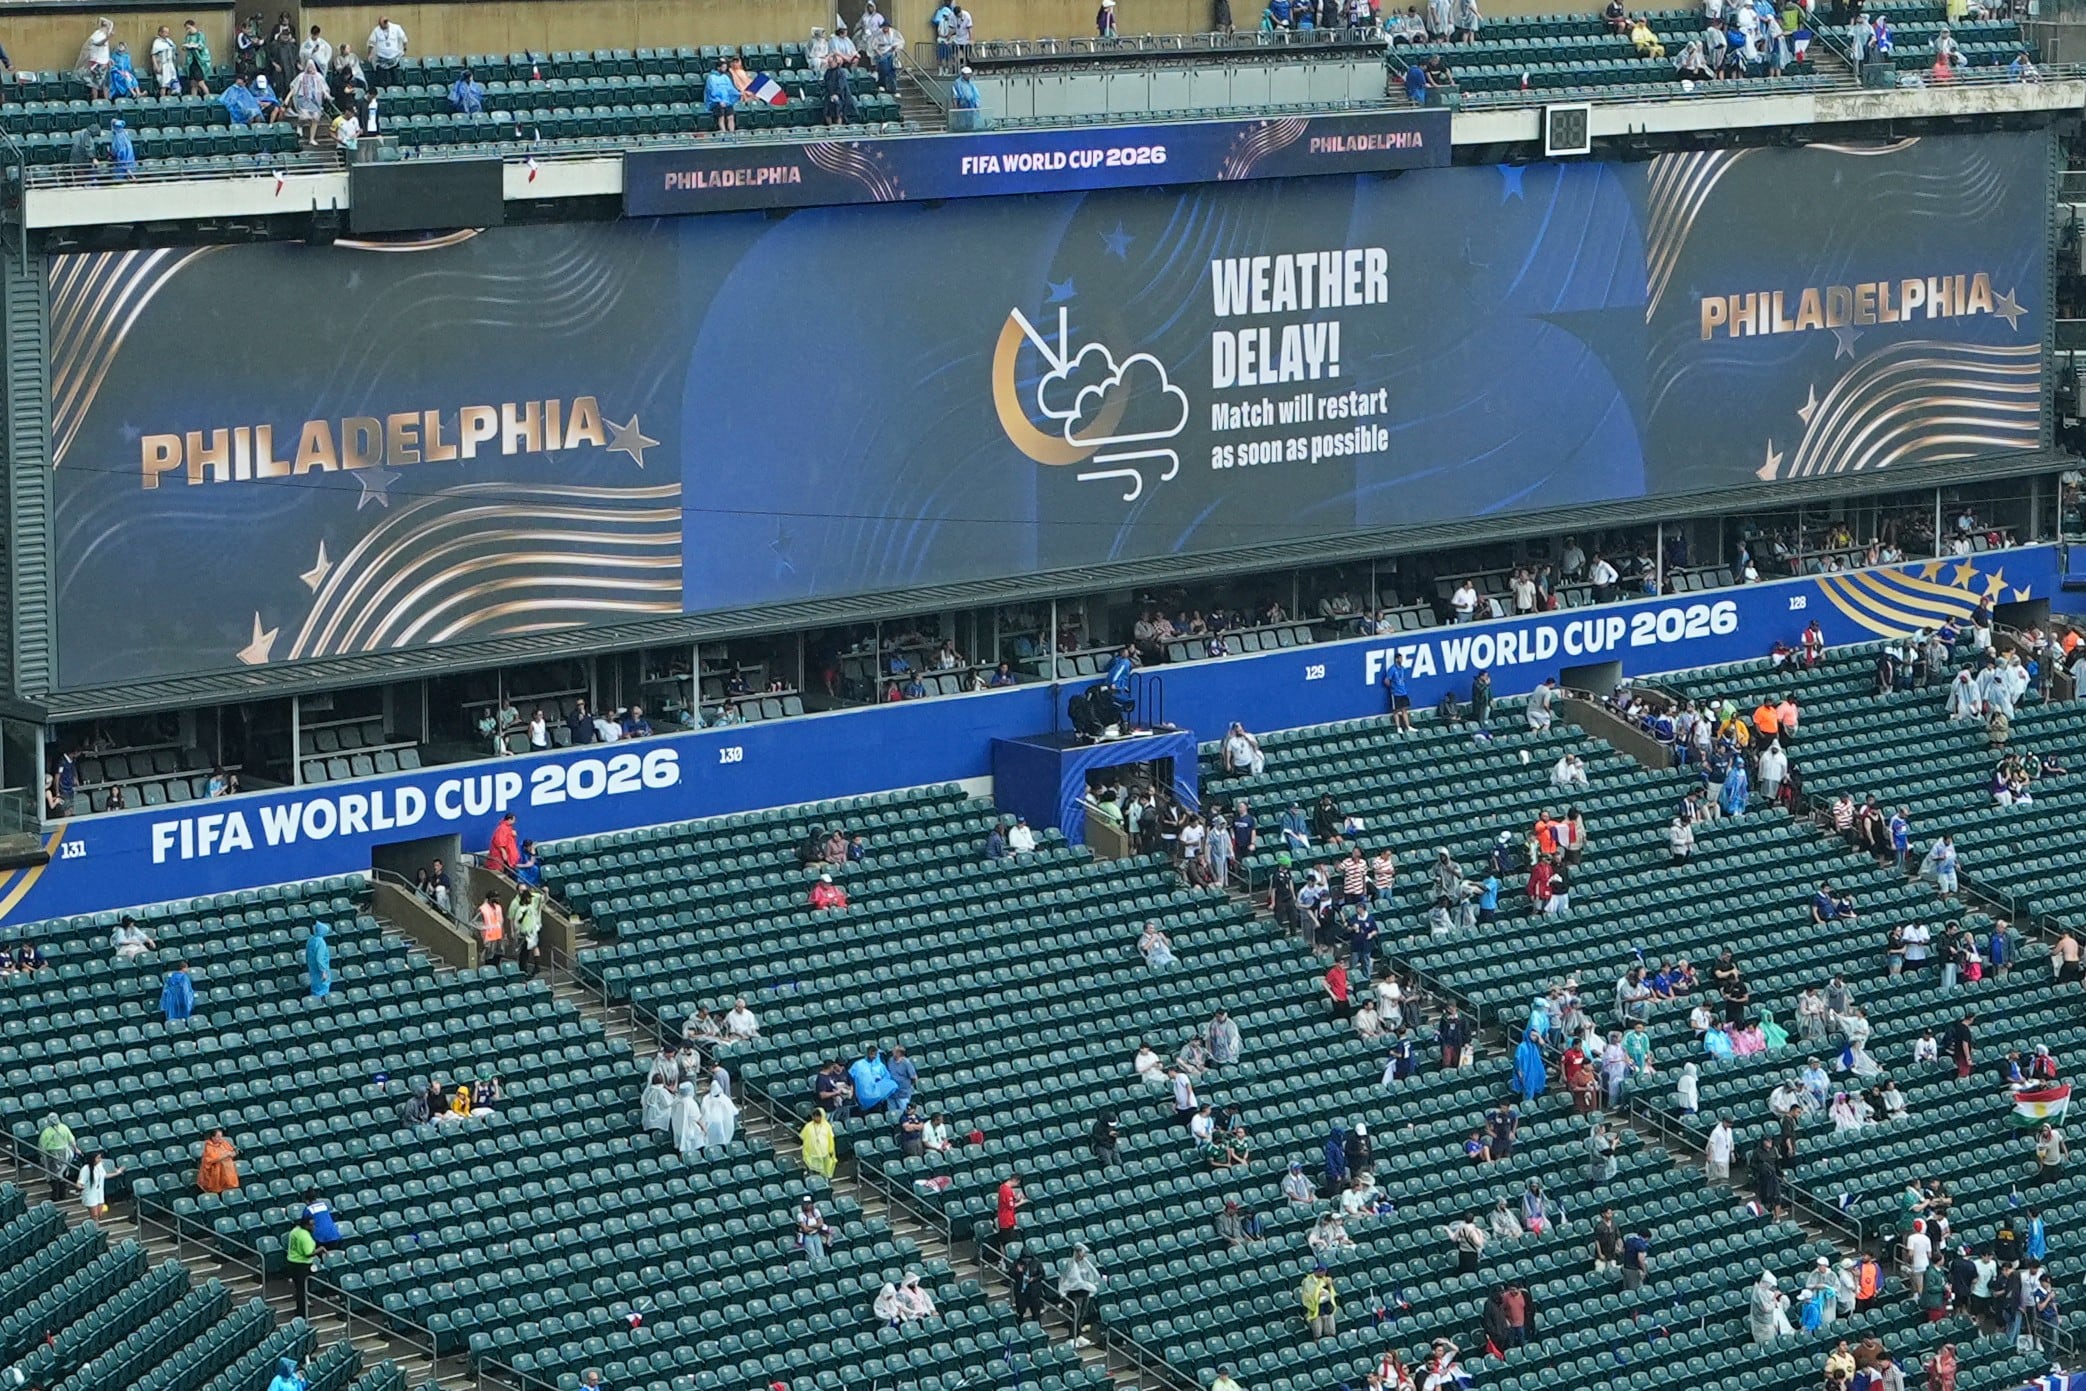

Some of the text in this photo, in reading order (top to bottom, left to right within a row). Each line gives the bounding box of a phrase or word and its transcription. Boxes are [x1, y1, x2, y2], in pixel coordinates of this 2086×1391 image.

[961, 145, 1167, 175] FIFA WORLD CUP 2026
[1309, 130, 1424, 154] PHILADELPHIA
[664, 165, 802, 191] PHILADELPHIA
[1211, 247, 1388, 317] WEATHER
[1699, 271, 1993, 341] PHILADELPHIA
[1212, 320, 1341, 389] DELAY!
[1211, 387, 1388, 432] Match will restart
[140, 395, 607, 490] PHILADELPHIA
[1211, 423, 1389, 470] as soon as possible
[1789, 595, 1807, 611] 128
[1365, 600, 1738, 686] FIFA WORLD CUP 2026
[1305, 664, 1326, 681] 129
[719, 746, 743, 764] 130
[152, 748, 680, 864] FIFA WORLD CUP 2026
[60, 840, 87, 860] 131
